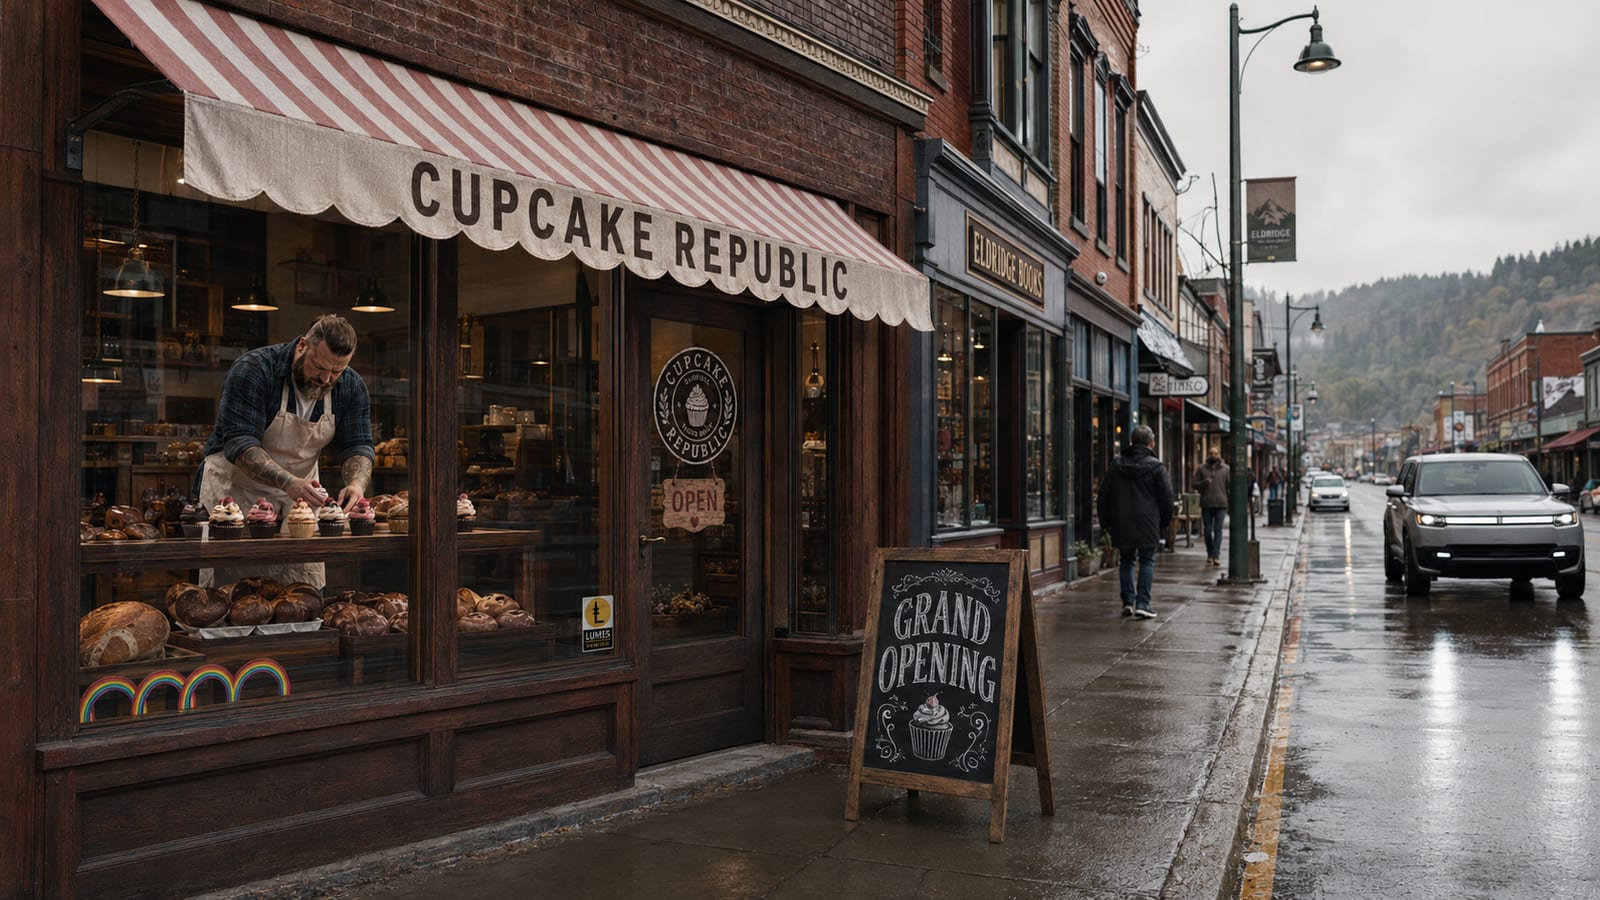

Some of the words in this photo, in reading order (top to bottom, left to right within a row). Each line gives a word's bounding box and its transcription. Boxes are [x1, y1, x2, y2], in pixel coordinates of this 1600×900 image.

[411, 161, 653, 261] CUPCAKE
[675, 221, 848, 300] REPUBLIC
[1251, 229, 1291, 239] ELDRIDGE
[974, 231, 1017, 285] ELDRIDGE
[1018, 258, 1043, 298] BOOKS
[665, 353, 728, 388] CUPCAKE
[666, 426, 728, 459] REPUBLIC
[672, 490, 717, 512] OPEN
[893, 590, 991, 645] GRAND
[878, 641, 997, 703] OPENING
